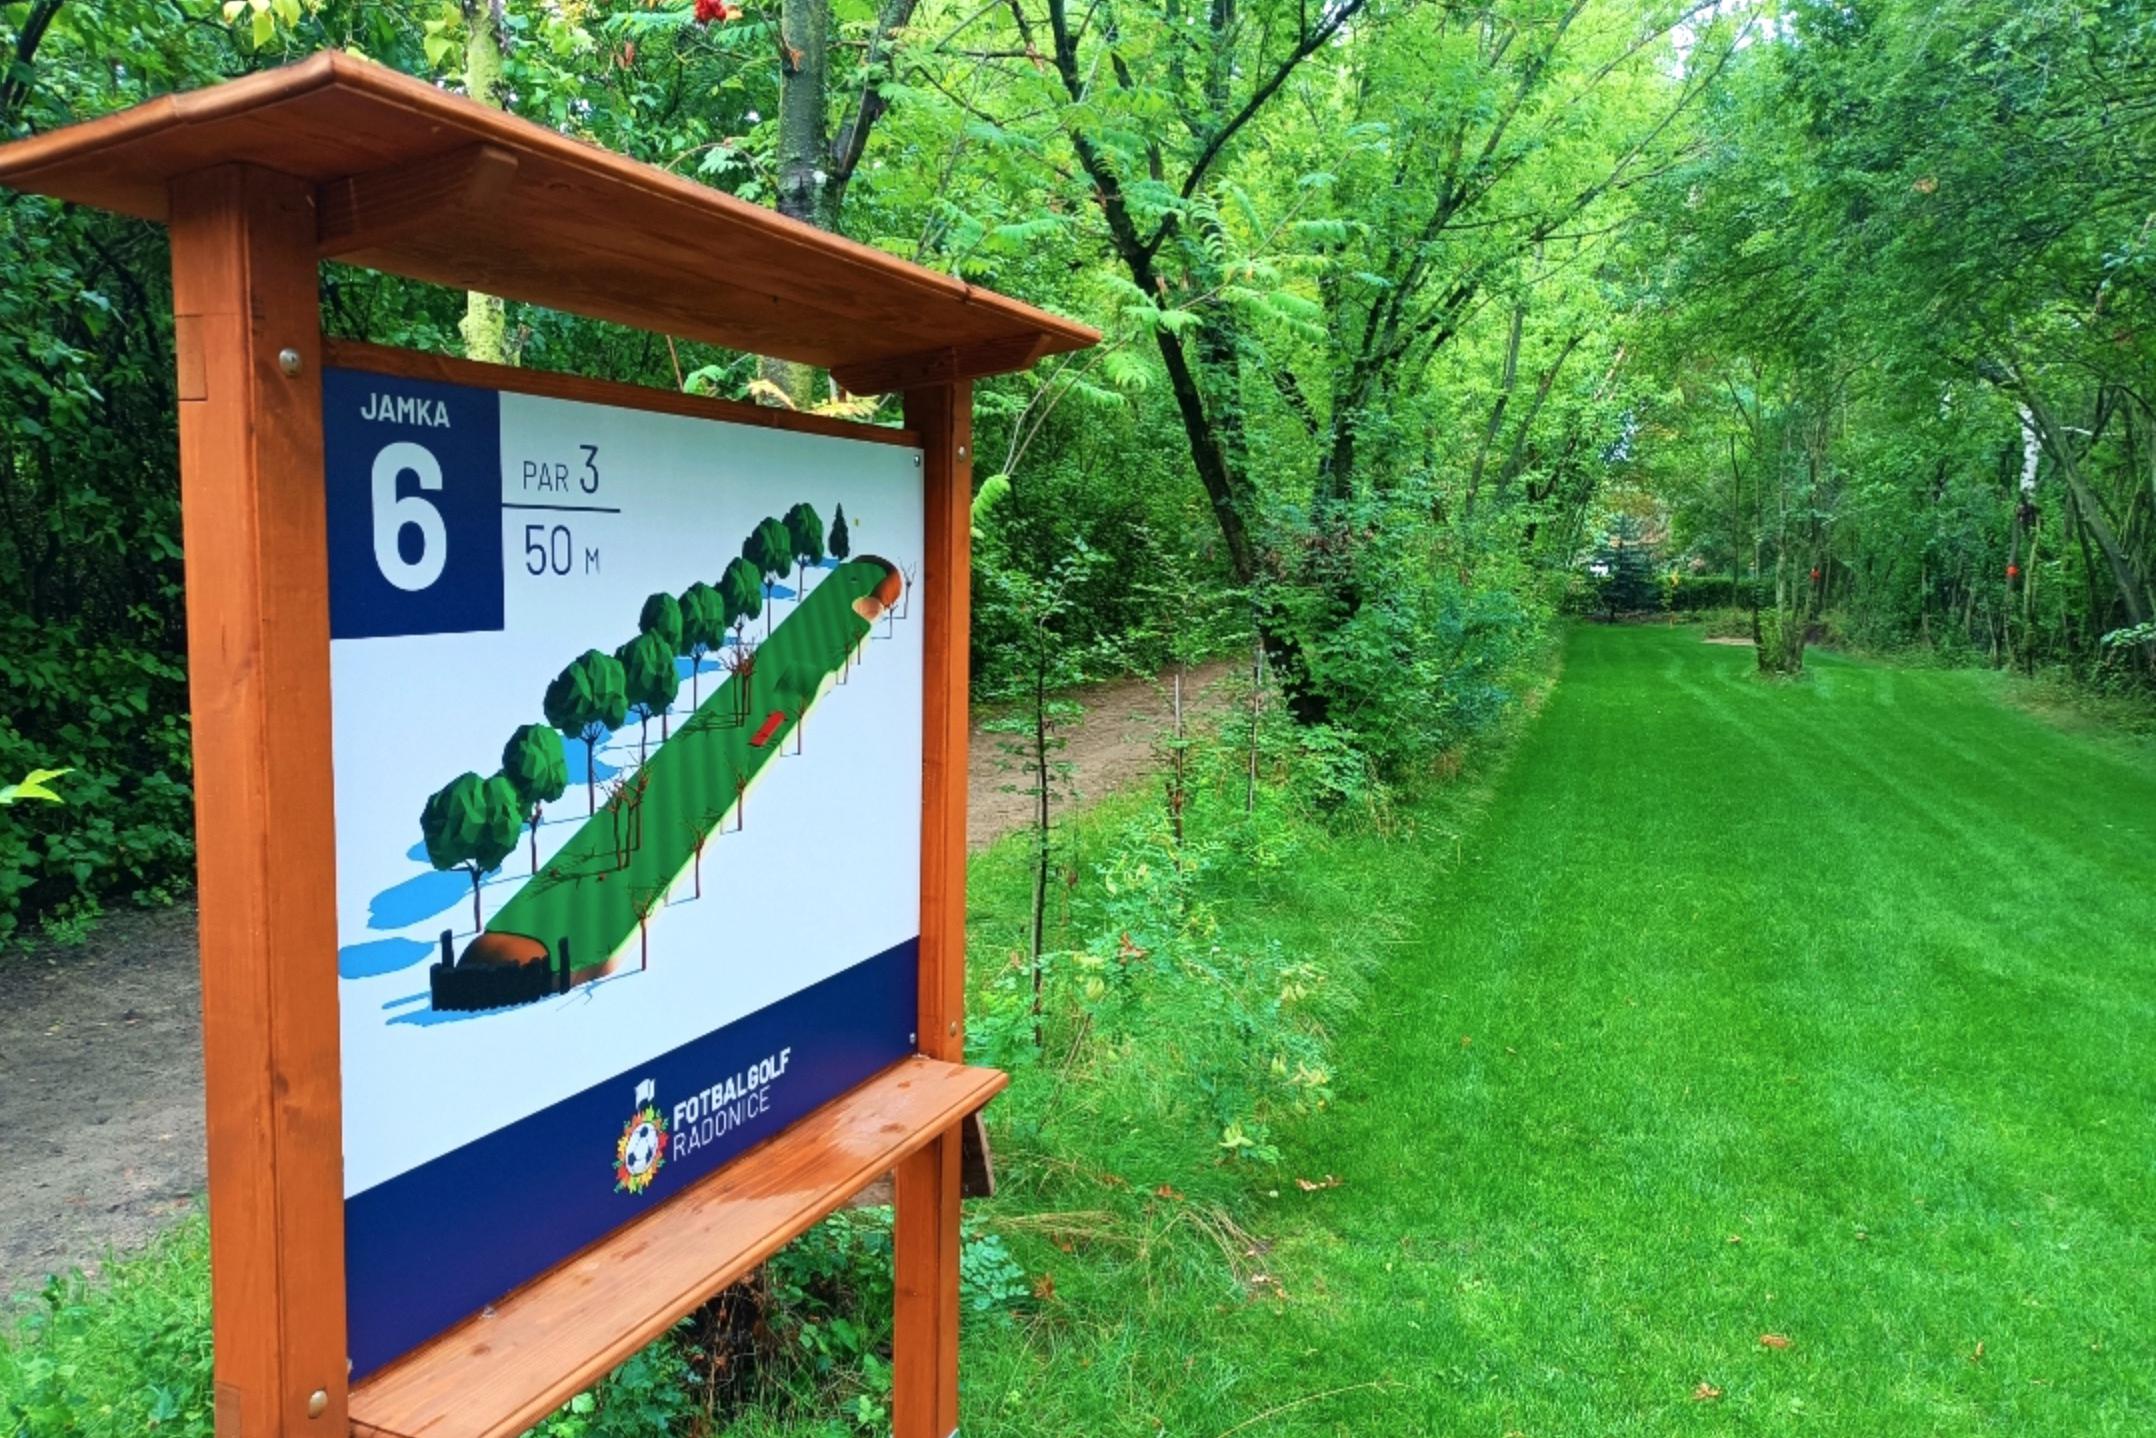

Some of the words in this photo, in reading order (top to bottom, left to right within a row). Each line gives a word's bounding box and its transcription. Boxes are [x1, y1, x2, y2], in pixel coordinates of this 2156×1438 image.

[360, 392, 451, 428] JAMKA
[523, 461, 569, 493] PAR
[579, 444, 599, 494] 3
[371, 441, 447, 592] 6
[525, 524, 572, 576] 50
[585, 547, 600, 575] M
[673, 1046, 791, 1132] FOTBALGOLF
[673, 1085, 771, 1162] RADONICE
